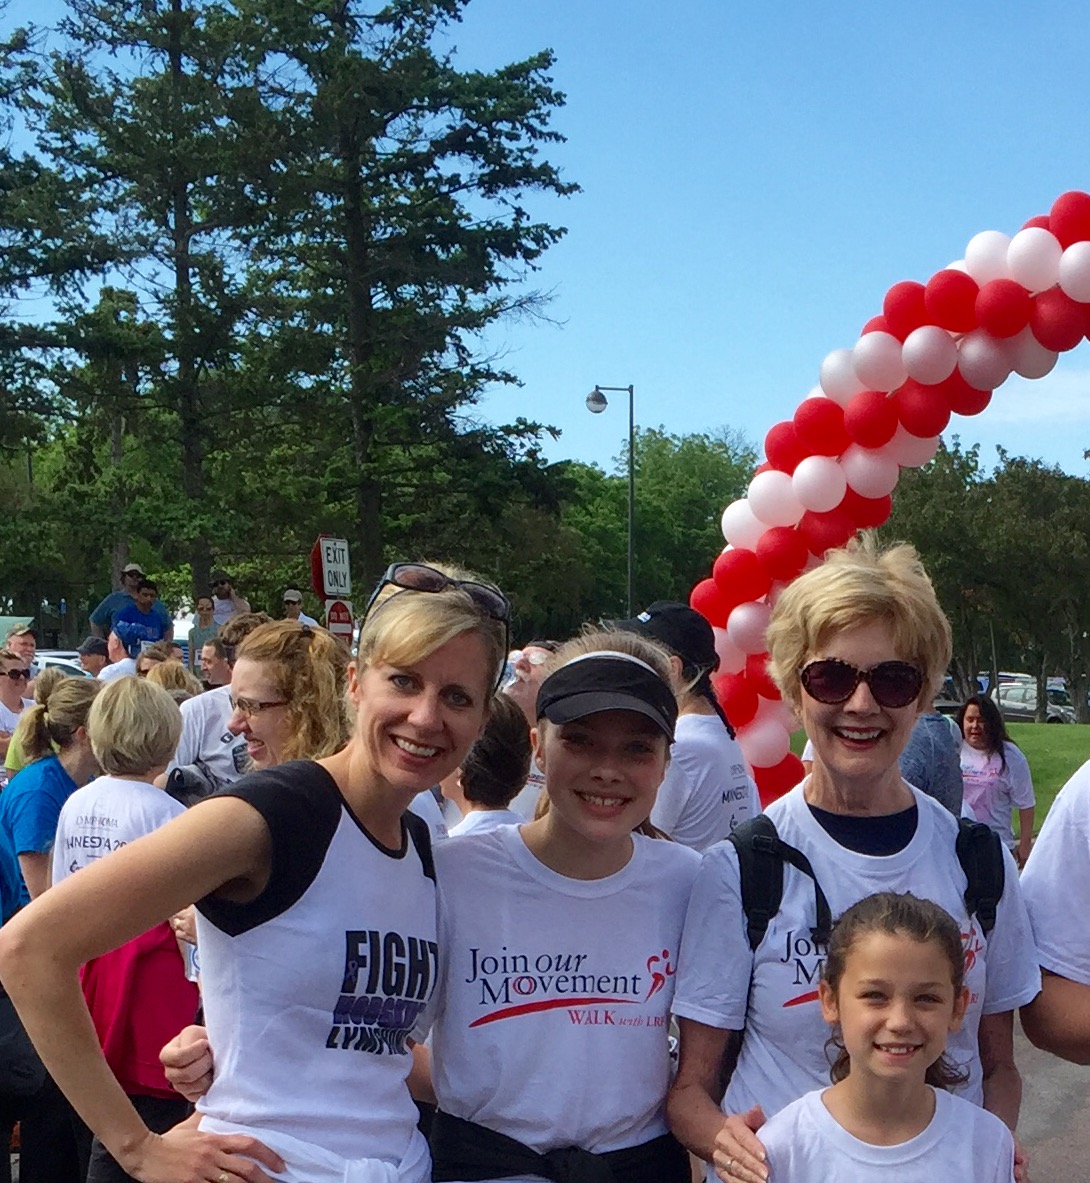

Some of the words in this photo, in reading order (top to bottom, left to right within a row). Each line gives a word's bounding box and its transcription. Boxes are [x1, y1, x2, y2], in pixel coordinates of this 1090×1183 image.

[326, 546, 346, 565] EXIT
[328, 570, 347, 588] ONLY
[466, 947, 530, 983] Join
[535, 953, 587, 974] our
[479, 973, 642, 1005] Movement
[568, 1009, 616, 1025] WALK
